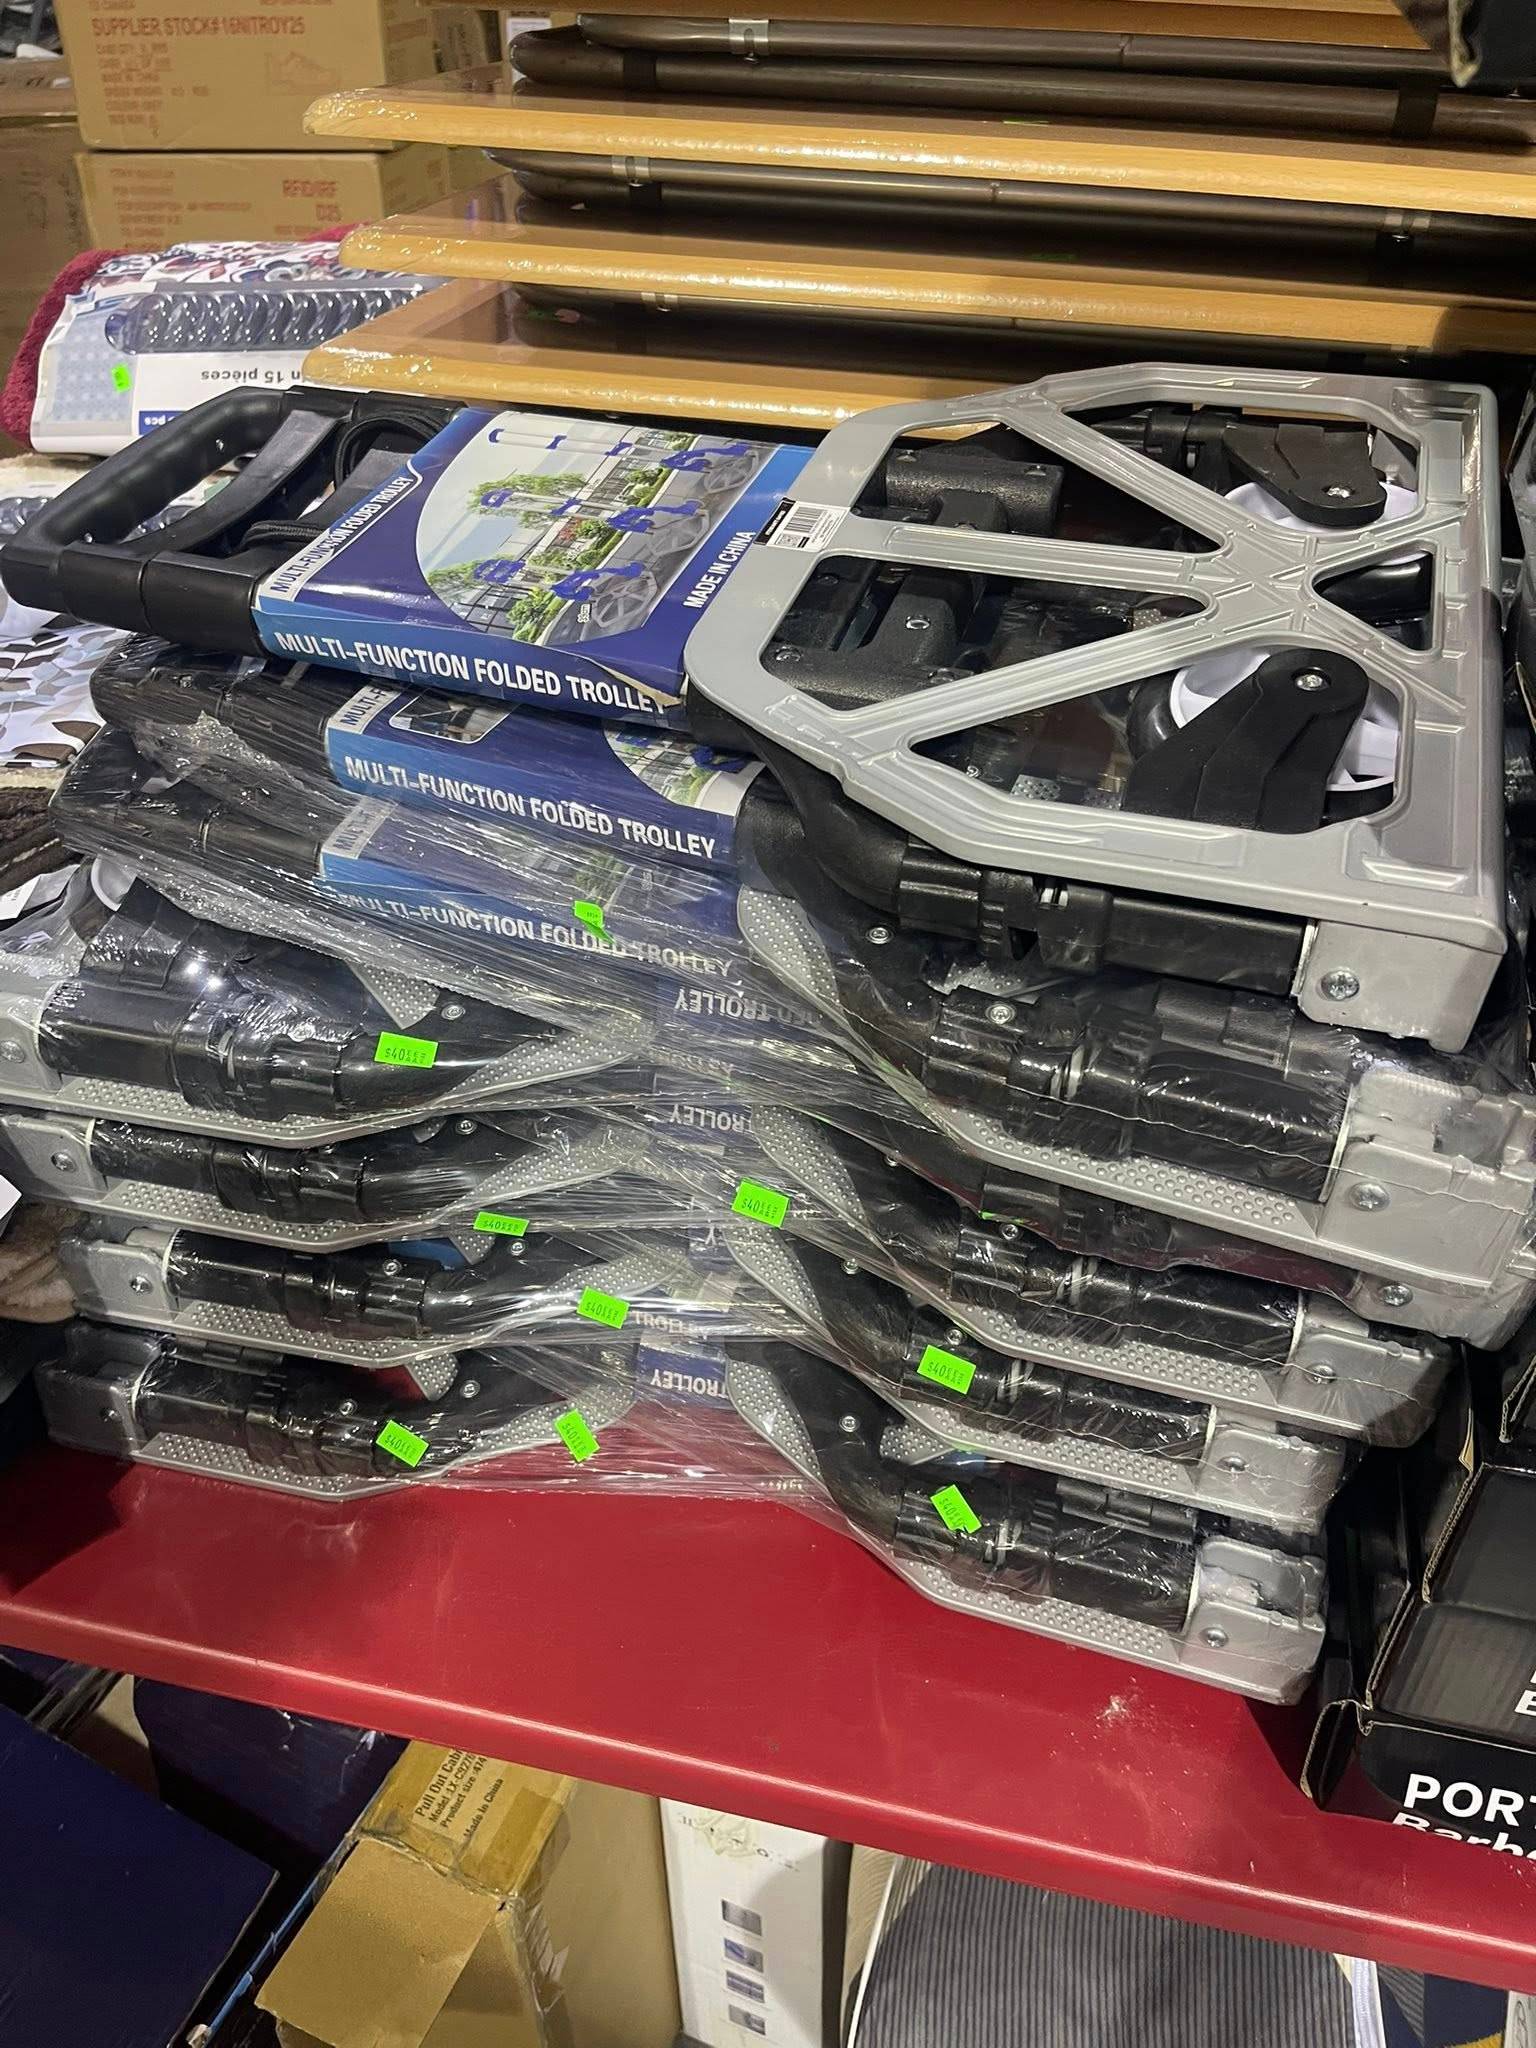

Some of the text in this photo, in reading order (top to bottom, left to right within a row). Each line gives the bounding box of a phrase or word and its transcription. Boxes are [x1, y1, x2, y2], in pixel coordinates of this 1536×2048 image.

[201, 369, 258, 381] pièces
[265, 371, 284, 383] 15
[270, 476, 414, 593] MULTI-FUNCTION FOLDED TROLLEY
[682, 532, 756, 608] MADE IN CHINA
[273, 631, 666, 716] MULTI-FUNCTION FOLDED TROLLEY
[345, 756, 716, 860] MULTI-FUNCTION FOLDED TROLLEY
[674, 988, 770, 1022] TROLLEY
[414, 1794, 436, 1817] Pull
[429, 1774, 448, 1794] Out
[429, 1795, 450, 1823] Model
[440, 1793, 466, 1828] Product
